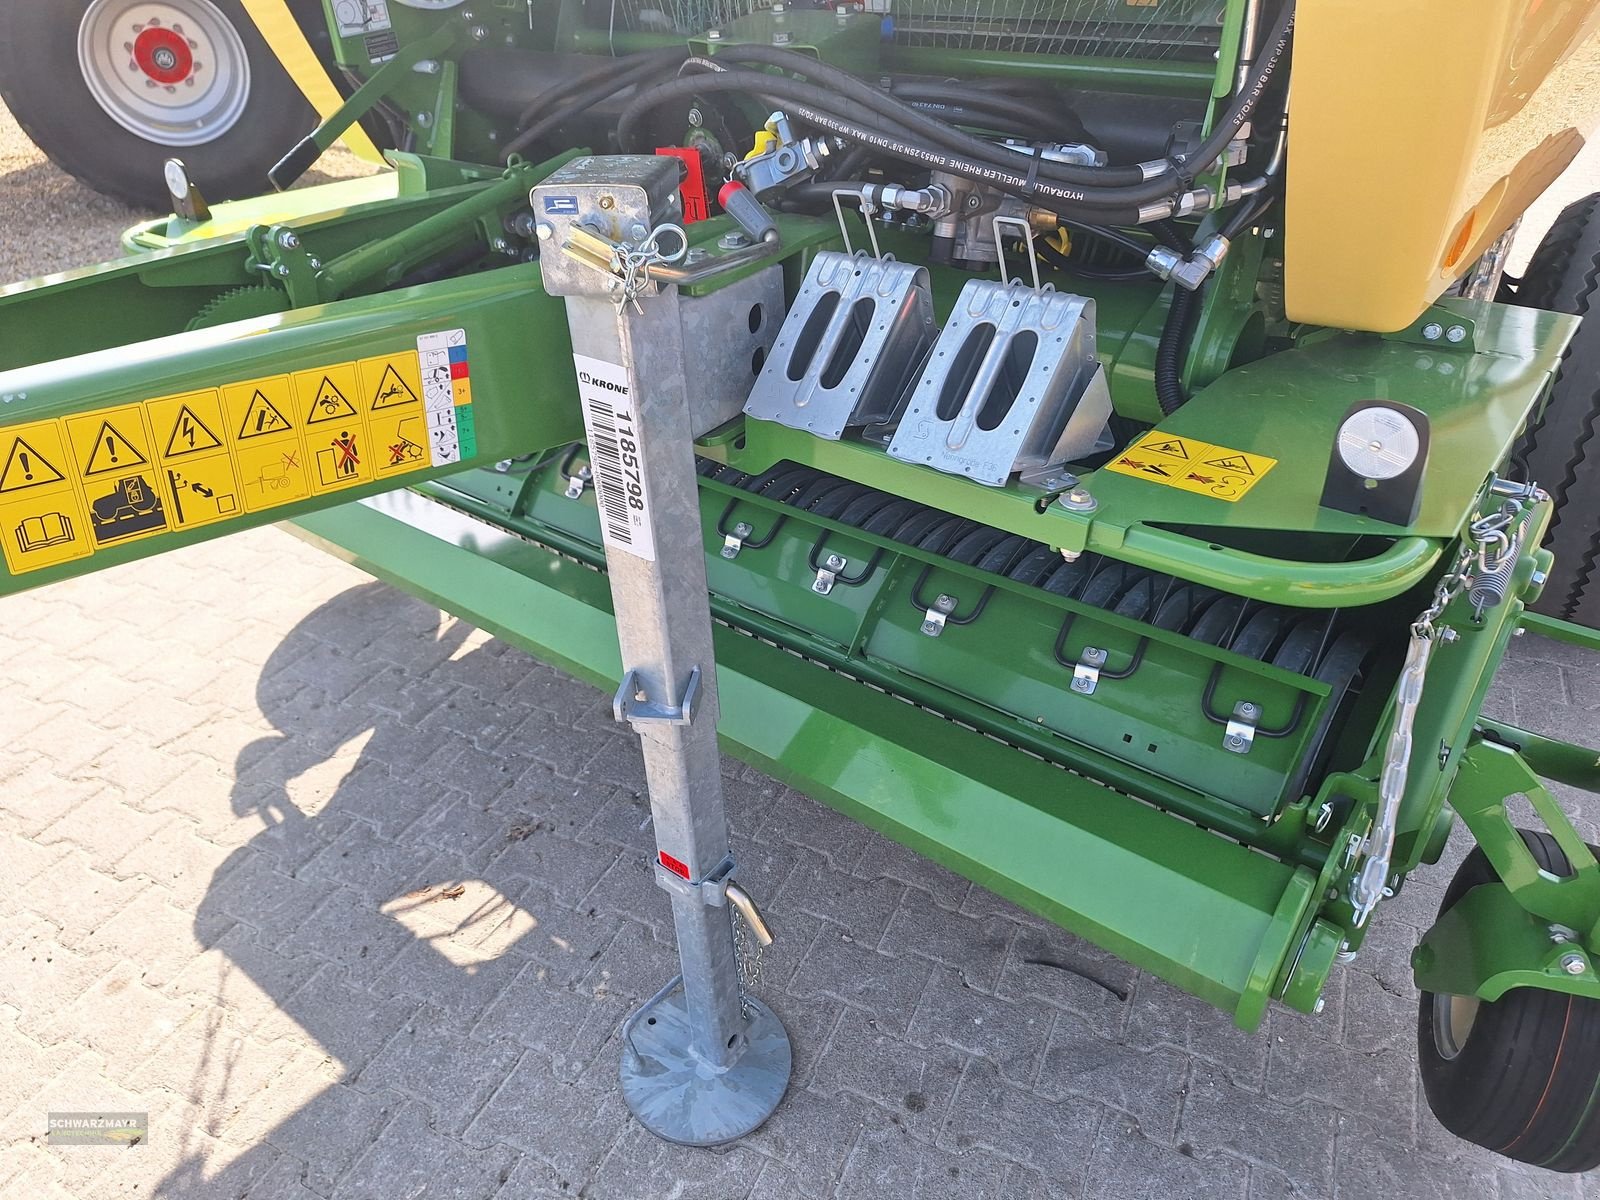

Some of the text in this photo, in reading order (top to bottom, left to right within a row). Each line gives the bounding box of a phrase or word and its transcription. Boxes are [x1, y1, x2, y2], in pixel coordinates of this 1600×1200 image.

[1275, 39, 1287, 56] WP
[1264, 56, 1278, 74] 330
[1251, 74, 1269, 97] BAR
[814, 113, 828, 126] BAR
[827, 120, 839, 130] 330
[838, 125, 850, 135] WP
[869, 135, 888, 148] DN10
[903, 146, 921, 157] 2SN
[920, 151, 946, 165] EN853
[949, 159, 982, 175] RHEINE
[983, 170, 1027, 187] MUELLER
[1032, 181, 1084, 201] HYDRAULI
[591, 377, 629, 396] KRONE
[615, 410, 644, 511] 1185798
